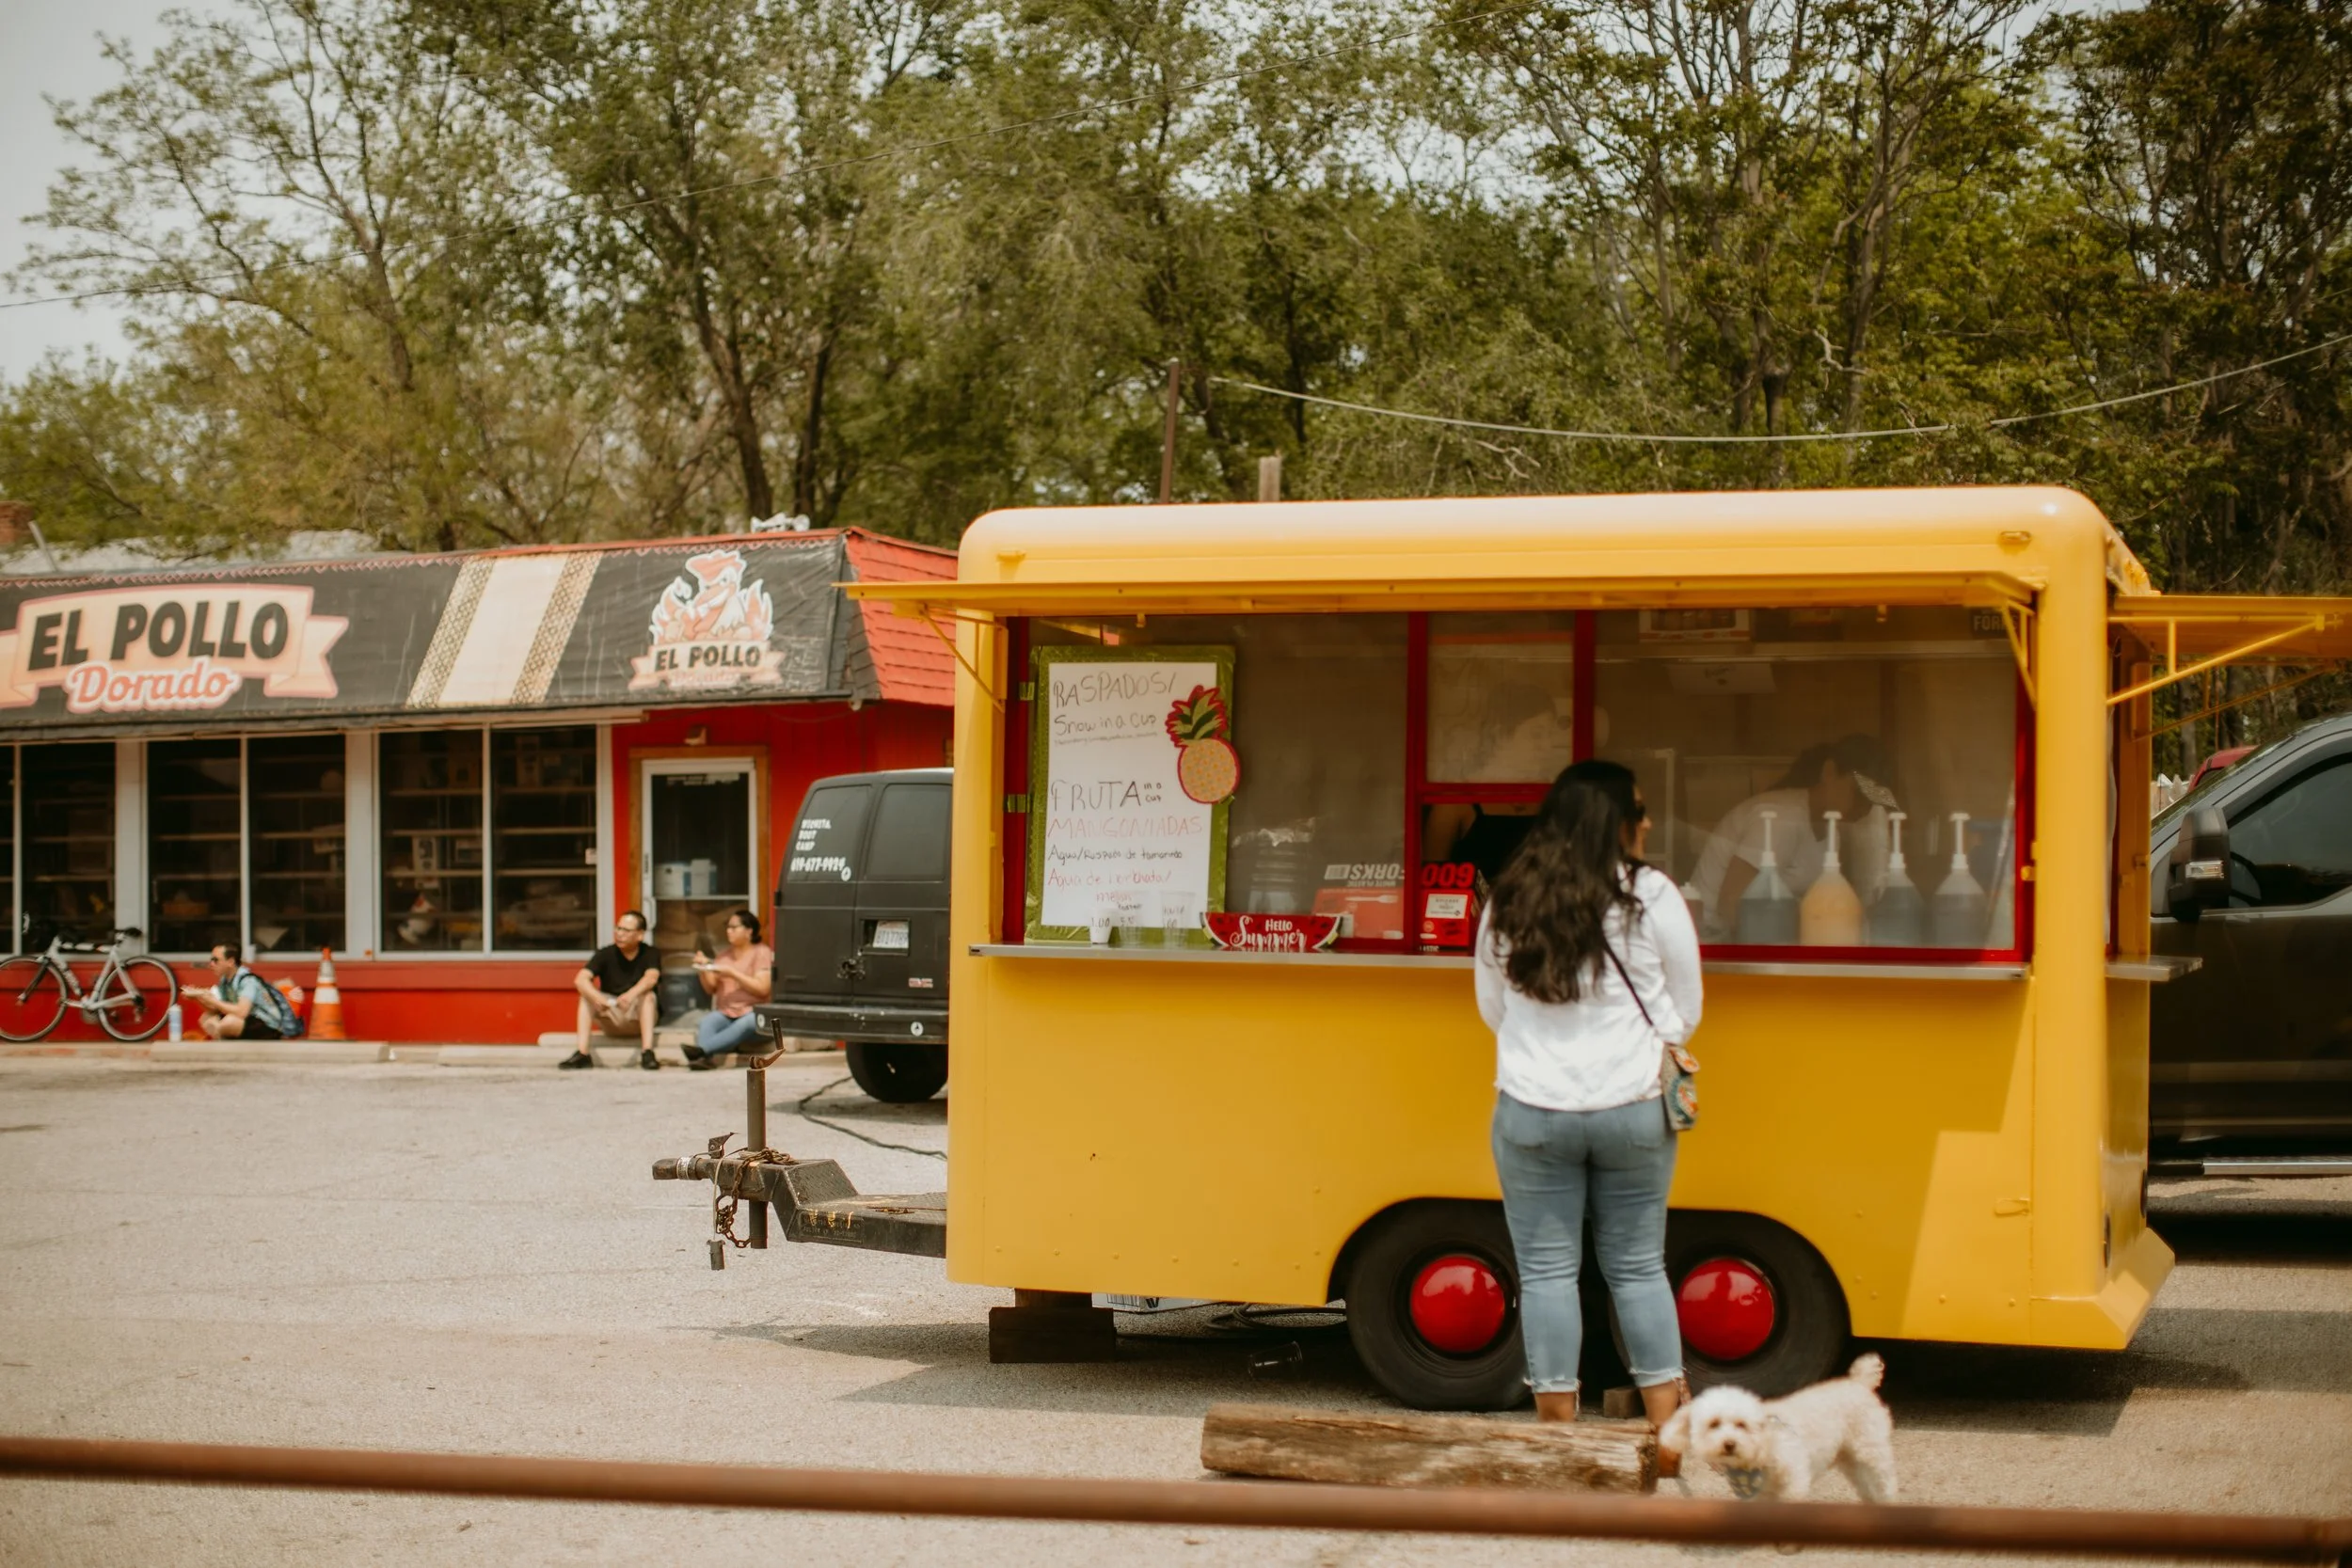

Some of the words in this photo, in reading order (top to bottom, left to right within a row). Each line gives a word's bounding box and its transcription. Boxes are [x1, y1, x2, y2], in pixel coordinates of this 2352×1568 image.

[28, 610, 89, 671] EL
[111, 601, 289, 659] POLLO
[655, 648, 678, 672] EL
[689, 645, 760, 668] POLLO
[70, 661, 235, 705] Dorado
[1055, 714, 1096, 736] Snow
[1101, 717, 1114, 729] in
[1051, 780, 1141, 812] FRUTA
[796, 841, 816, 851] CAMP
[1048, 867, 1082, 890] Agua
[1230, 915, 1308, 947] Summer
[1264, 919, 1293, 931] HELLO
